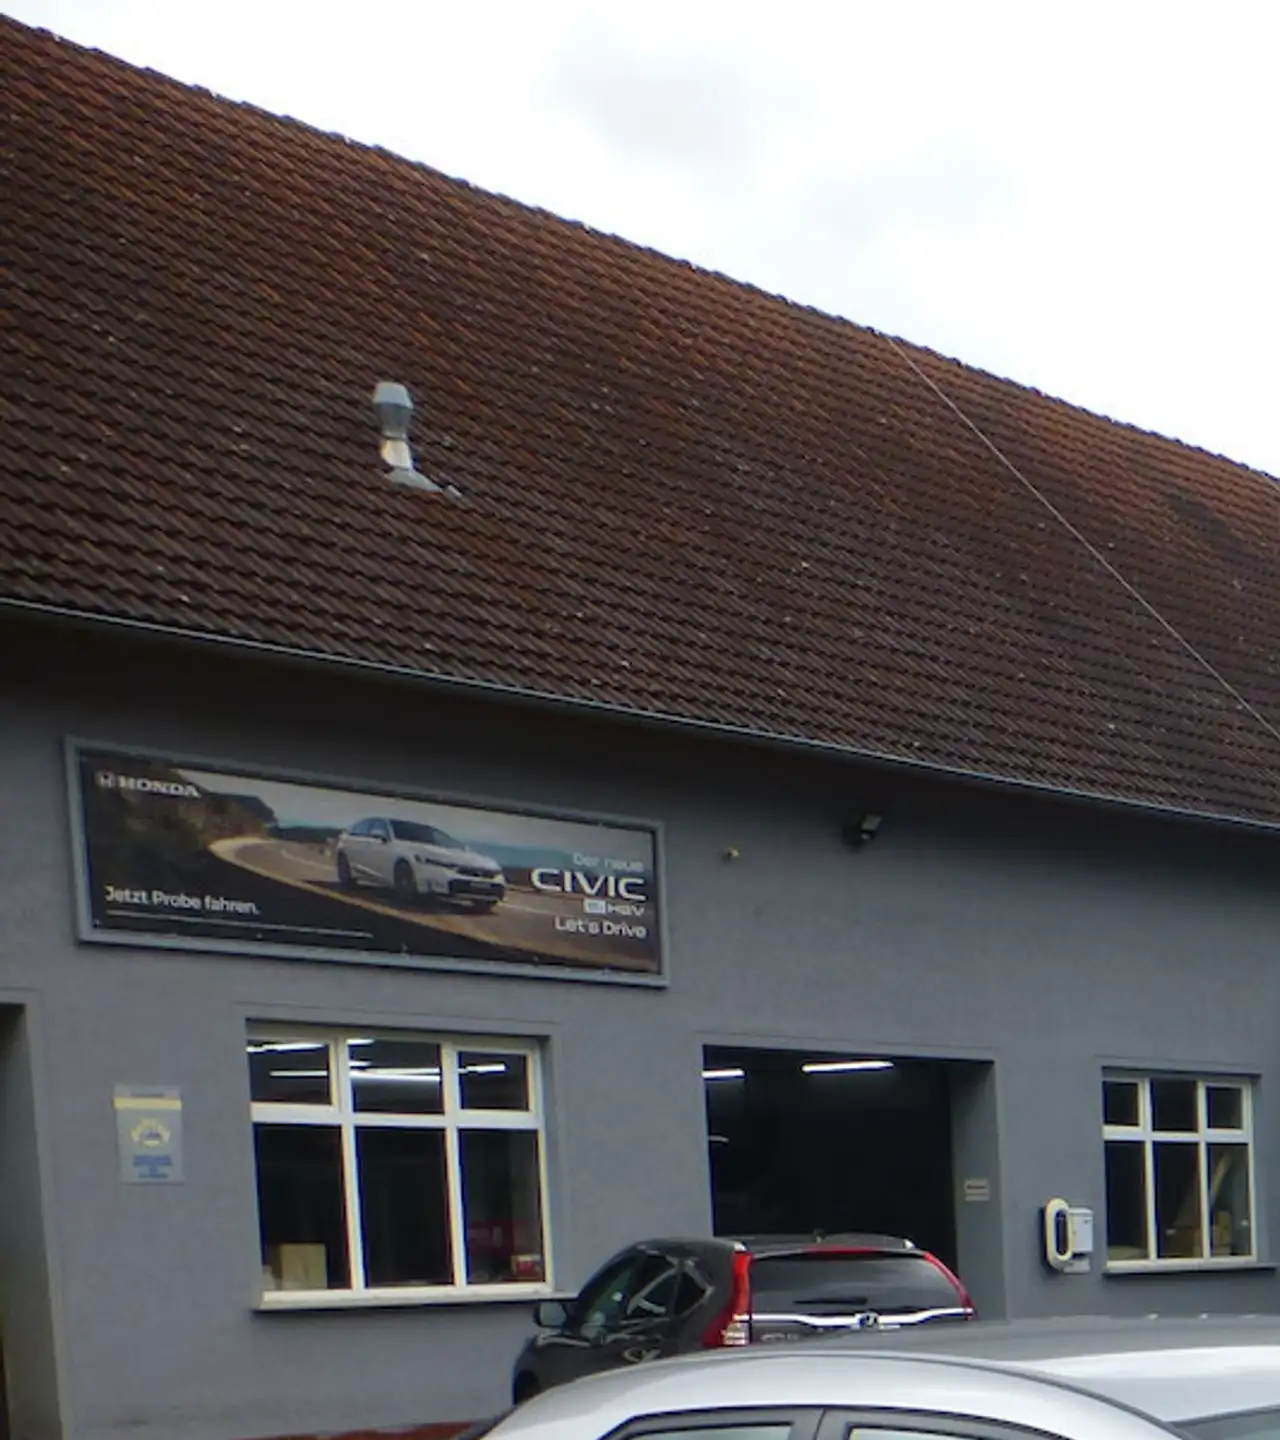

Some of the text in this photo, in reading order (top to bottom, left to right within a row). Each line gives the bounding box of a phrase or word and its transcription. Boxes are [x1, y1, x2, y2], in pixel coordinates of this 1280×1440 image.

[118, 775, 201, 798] HONDA
[531, 867, 647, 901] CIVIC
[105, 885, 149, 904] Jetzt
[152, 889, 200, 909] Probe
[554, 915, 647, 939] Let's Drive
